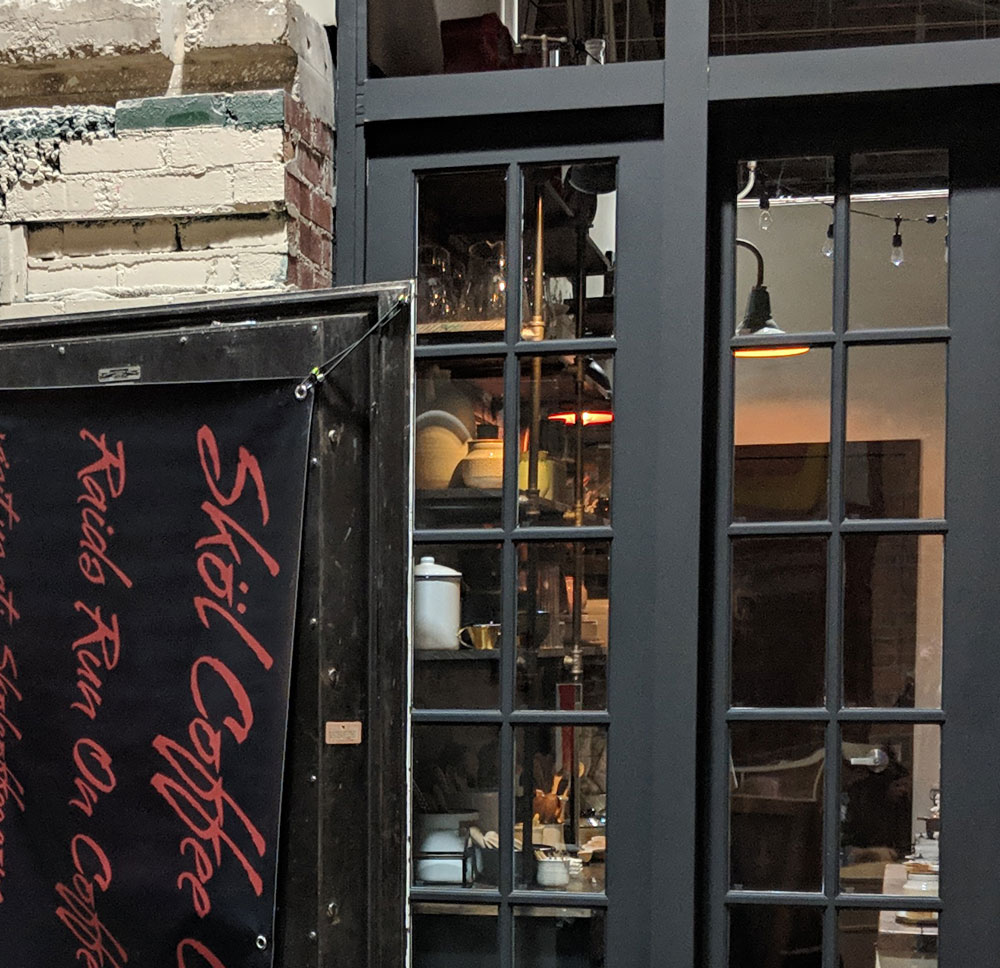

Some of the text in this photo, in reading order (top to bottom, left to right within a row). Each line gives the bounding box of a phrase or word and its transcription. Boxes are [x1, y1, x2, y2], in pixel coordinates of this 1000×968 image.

[77, 428, 133, 588] Raids
[195, 424, 280, 671] Sköl
[70, 600, 121, 720] Run
[69, 737, 117, 817] On
[151, 655, 266, 918] Coffee
